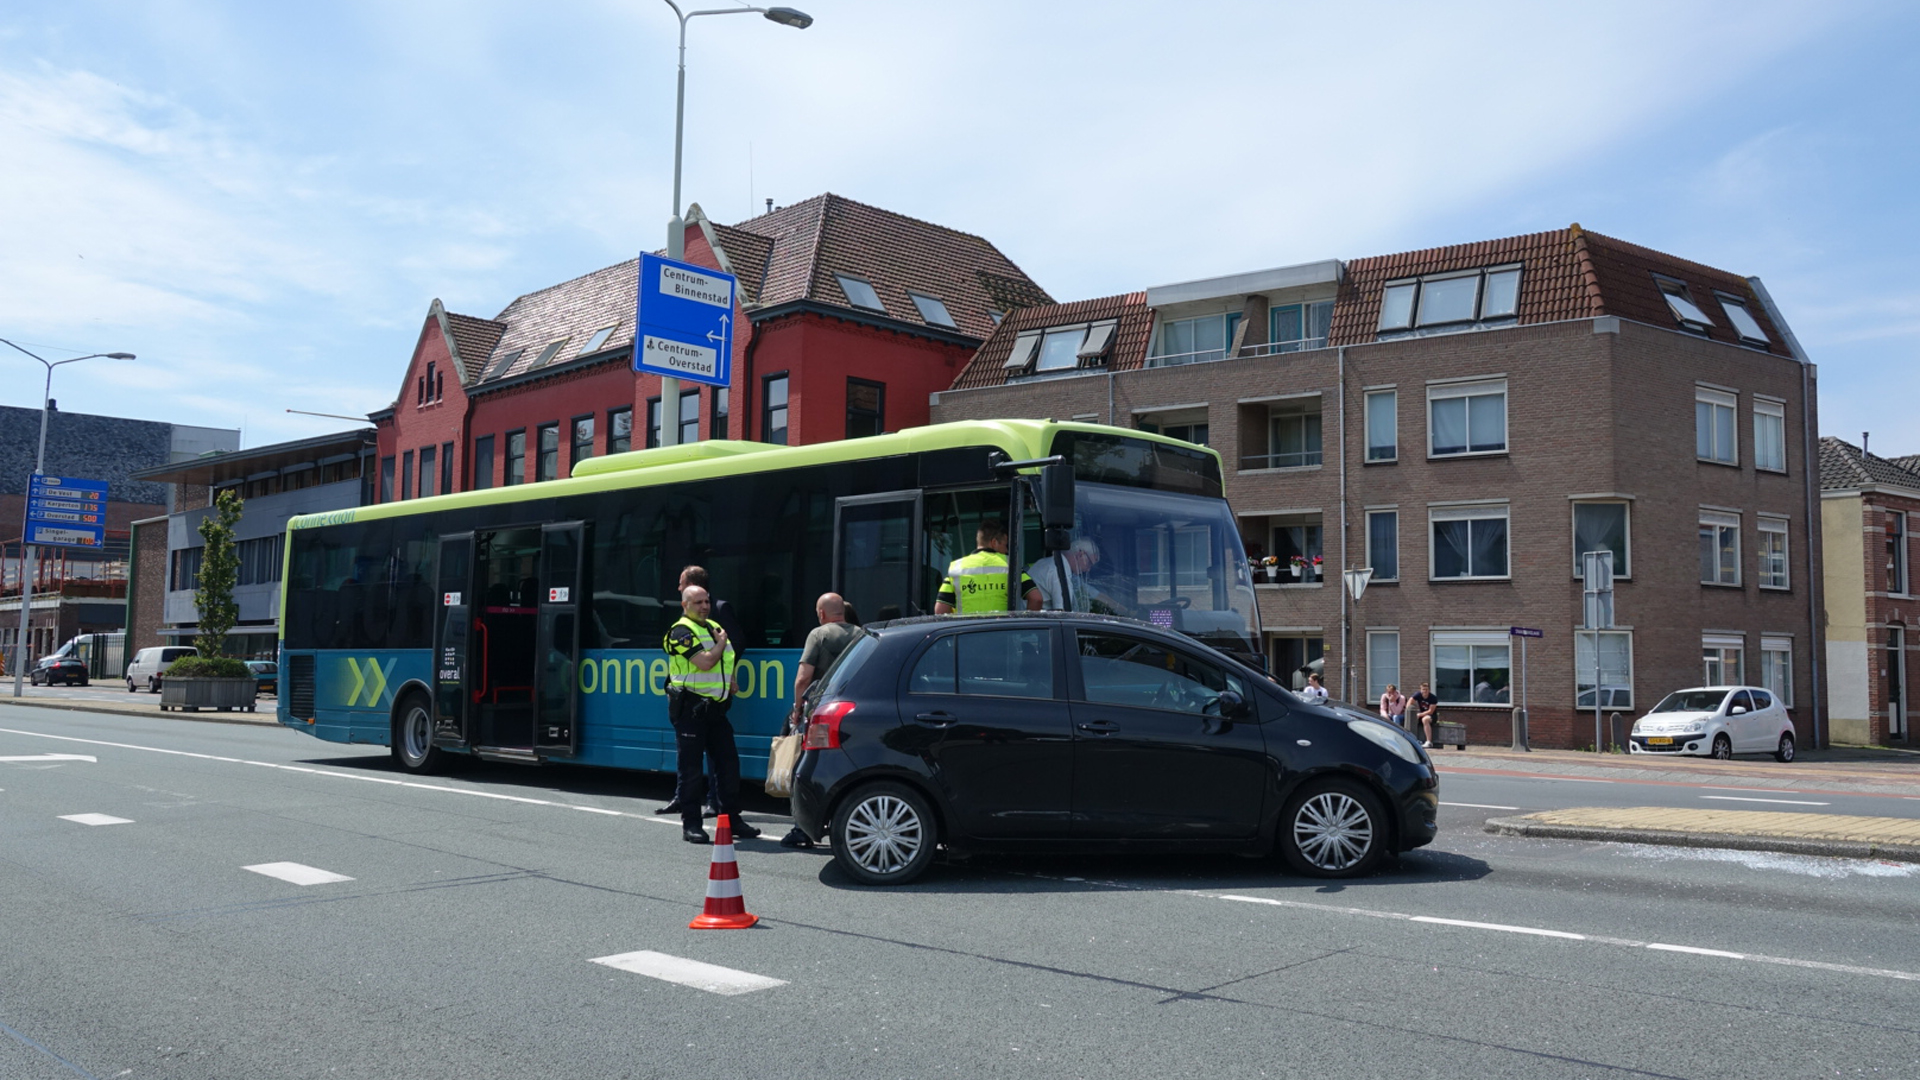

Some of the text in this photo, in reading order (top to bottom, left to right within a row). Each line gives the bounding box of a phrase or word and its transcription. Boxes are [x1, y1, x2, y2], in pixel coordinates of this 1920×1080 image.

[664, 268, 708, 286] Centrum-
[675, 284, 728, 305] Binnenstad
[658, 341, 703, 357] Centrum-
[669, 356, 712, 373] Overstad
[46, 512, 75, 520] Overstad
[961, 580, 1006, 594] POLITIE
